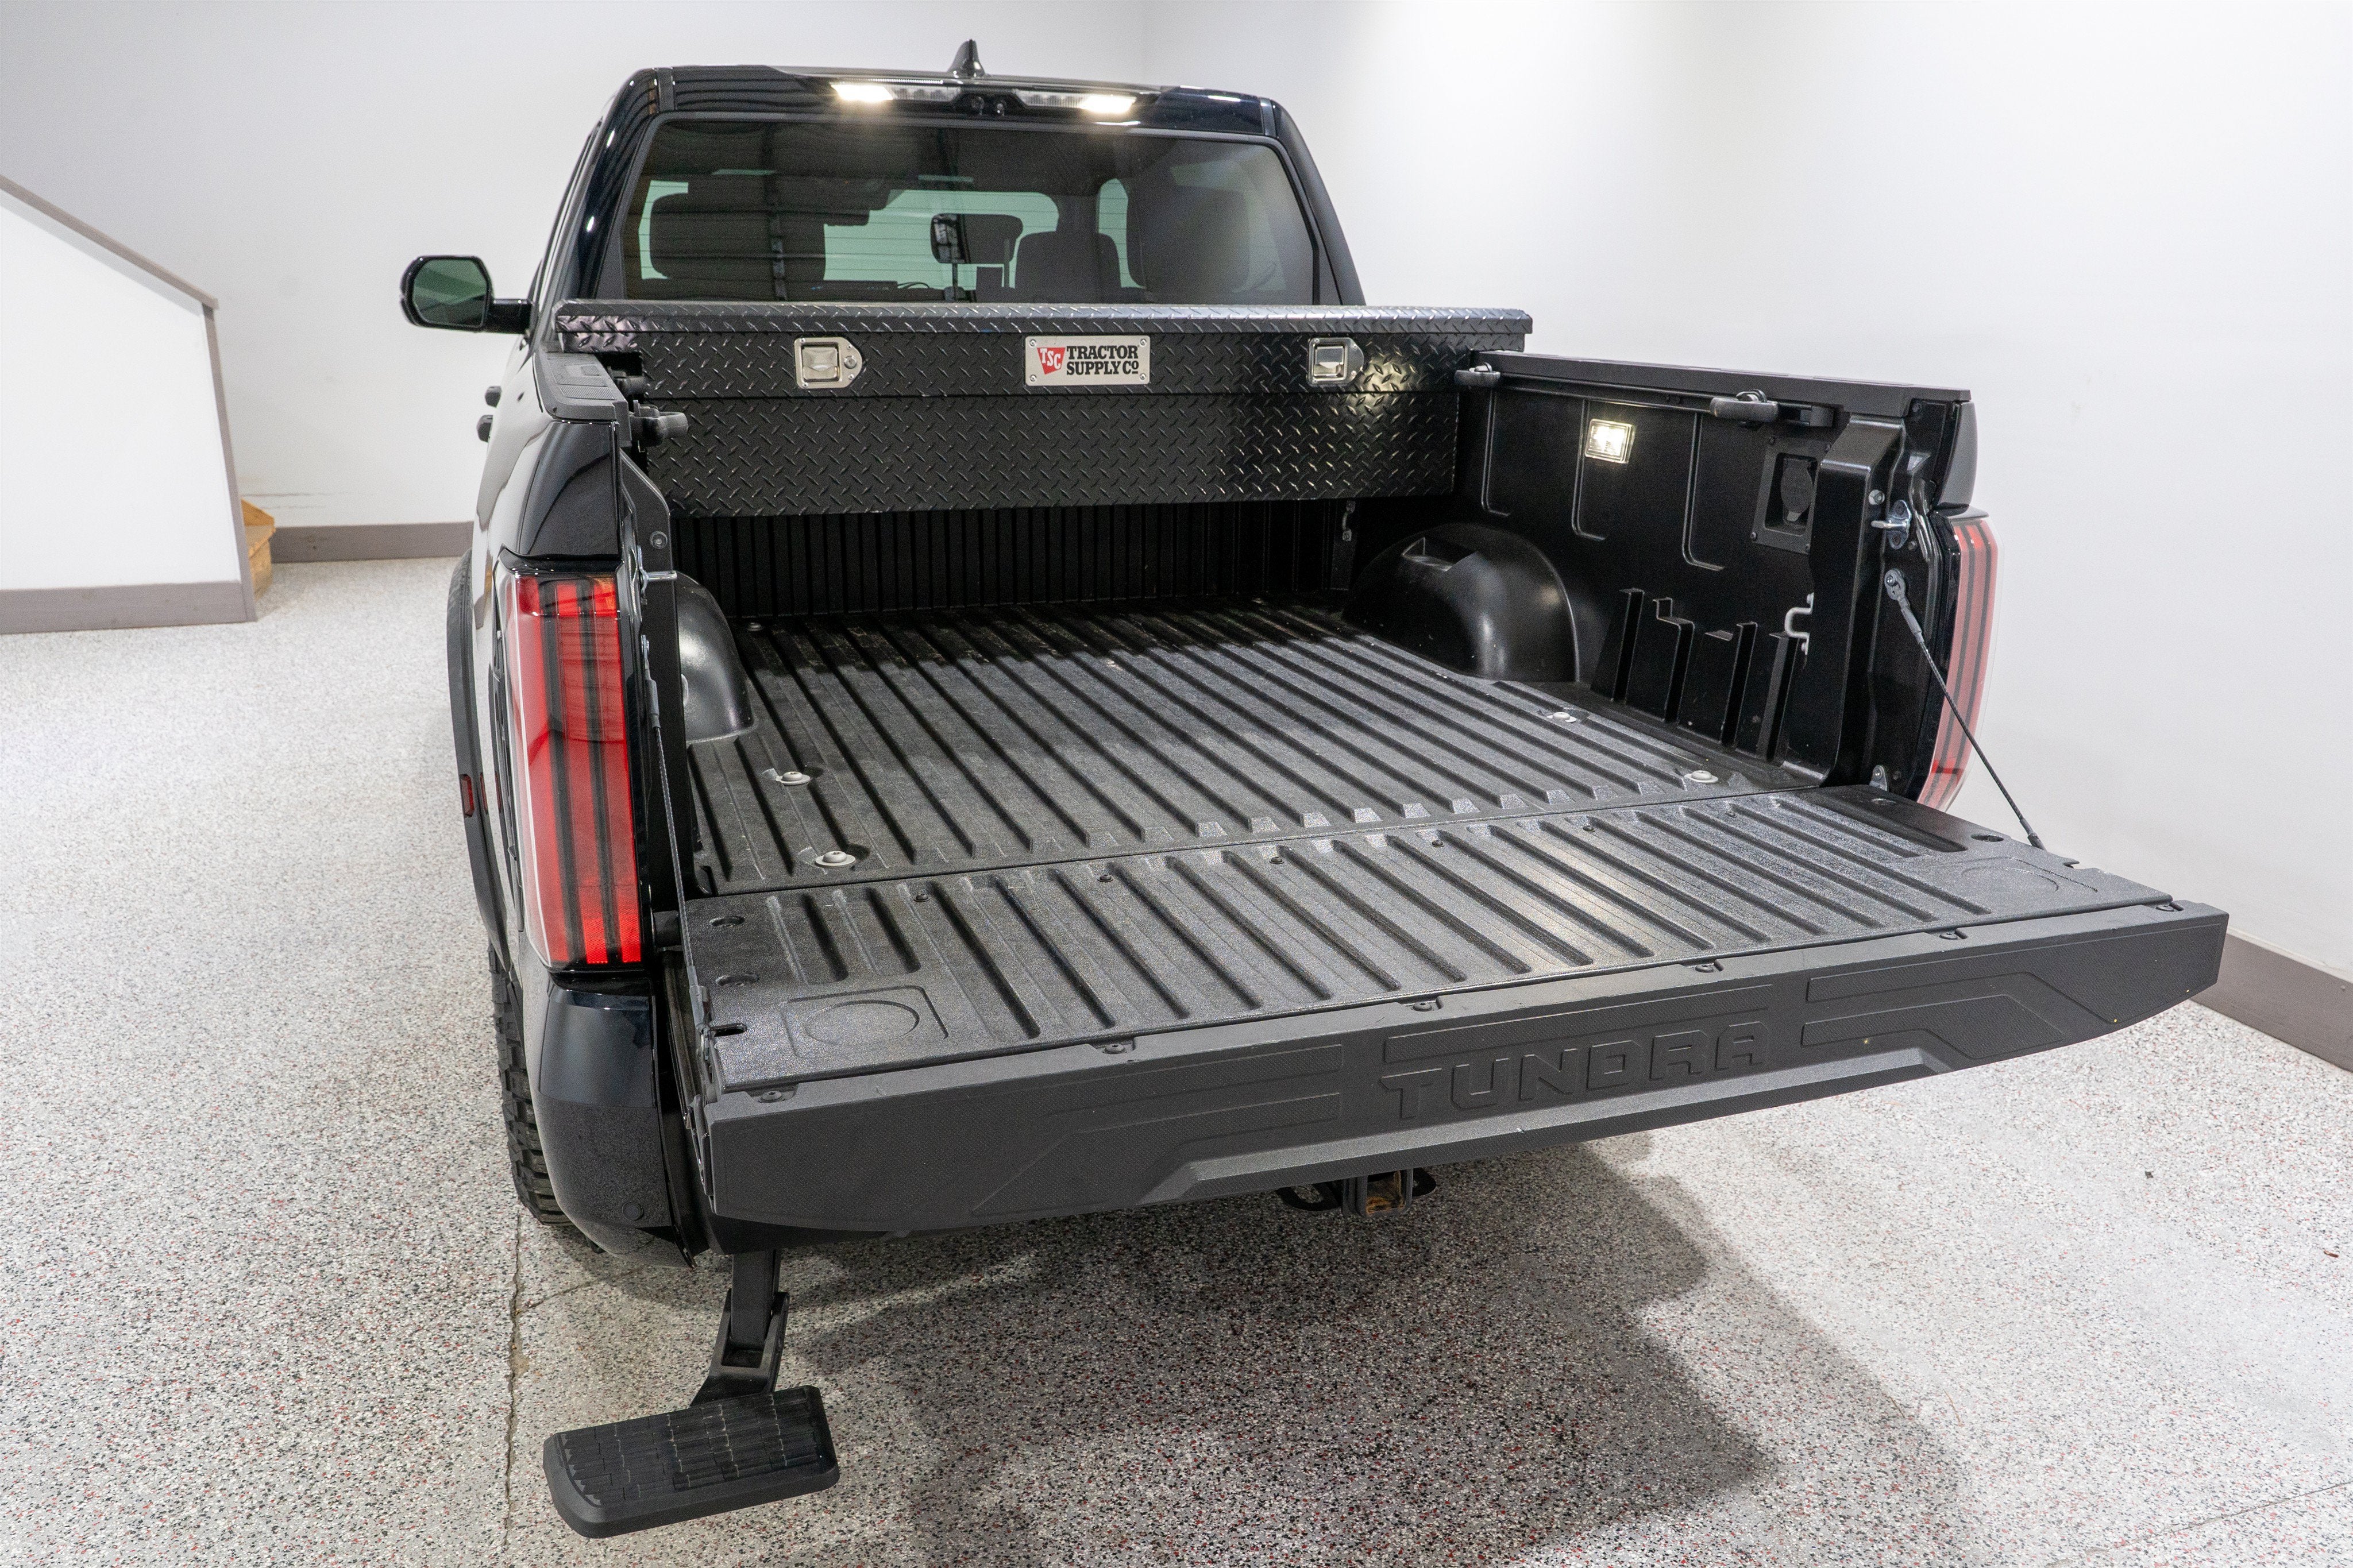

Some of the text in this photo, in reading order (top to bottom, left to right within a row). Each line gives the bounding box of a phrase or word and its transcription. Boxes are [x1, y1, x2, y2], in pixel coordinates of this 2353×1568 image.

[1040, 348, 1061, 369] TSC
[1067, 346, 1139, 360] TRACTOR
[1067, 361, 1120, 375] SUPPLY
[1380, 1021, 1769, 1119] TUNDRA
